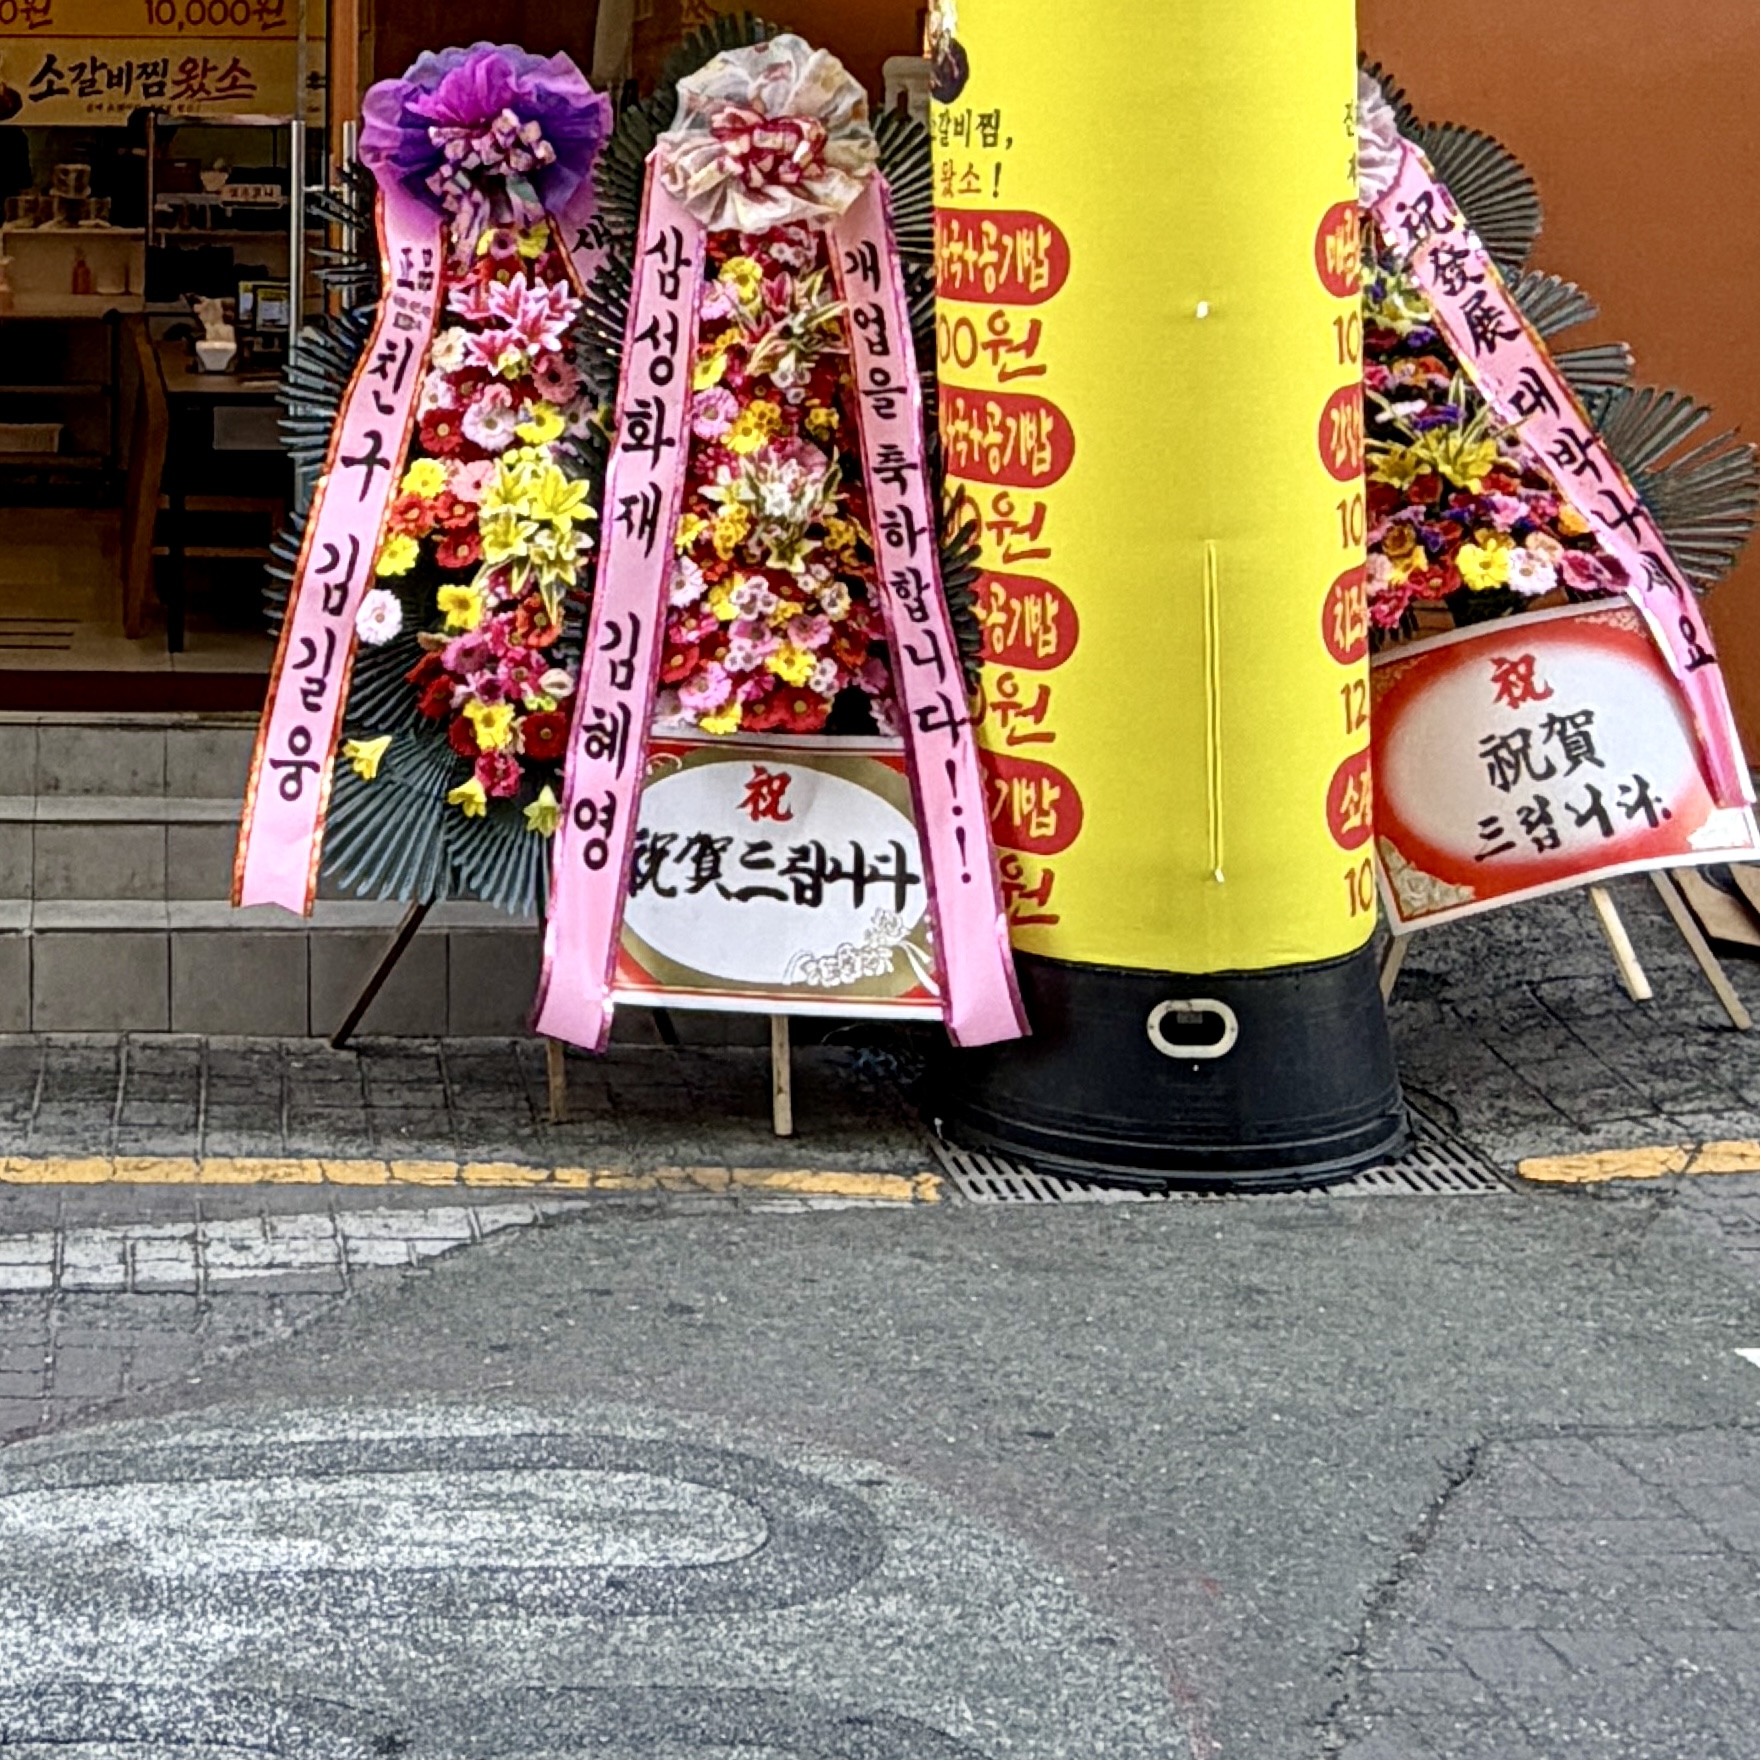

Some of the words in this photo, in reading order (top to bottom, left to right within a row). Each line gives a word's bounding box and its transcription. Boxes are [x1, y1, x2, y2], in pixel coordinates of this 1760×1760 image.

[931, 107, 1014, 151] 갈비찜,
[935, 216, 1052, 295] +국+공기밥
[842, 240, 907, 420] 개업을
[340, 337, 415, 503] 친구
[613, 225, 691, 560] 삼성화재
[940, 397, 1054, 477] +국+공기밥
[270, 534, 359, 801] 김길웅
[1490, 653, 1555, 710] 祝
[573, 611, 642, 870] 김혜영
[1478, 708, 1606, 793] 祝賀
[737, 764, 795, 823] 祝
